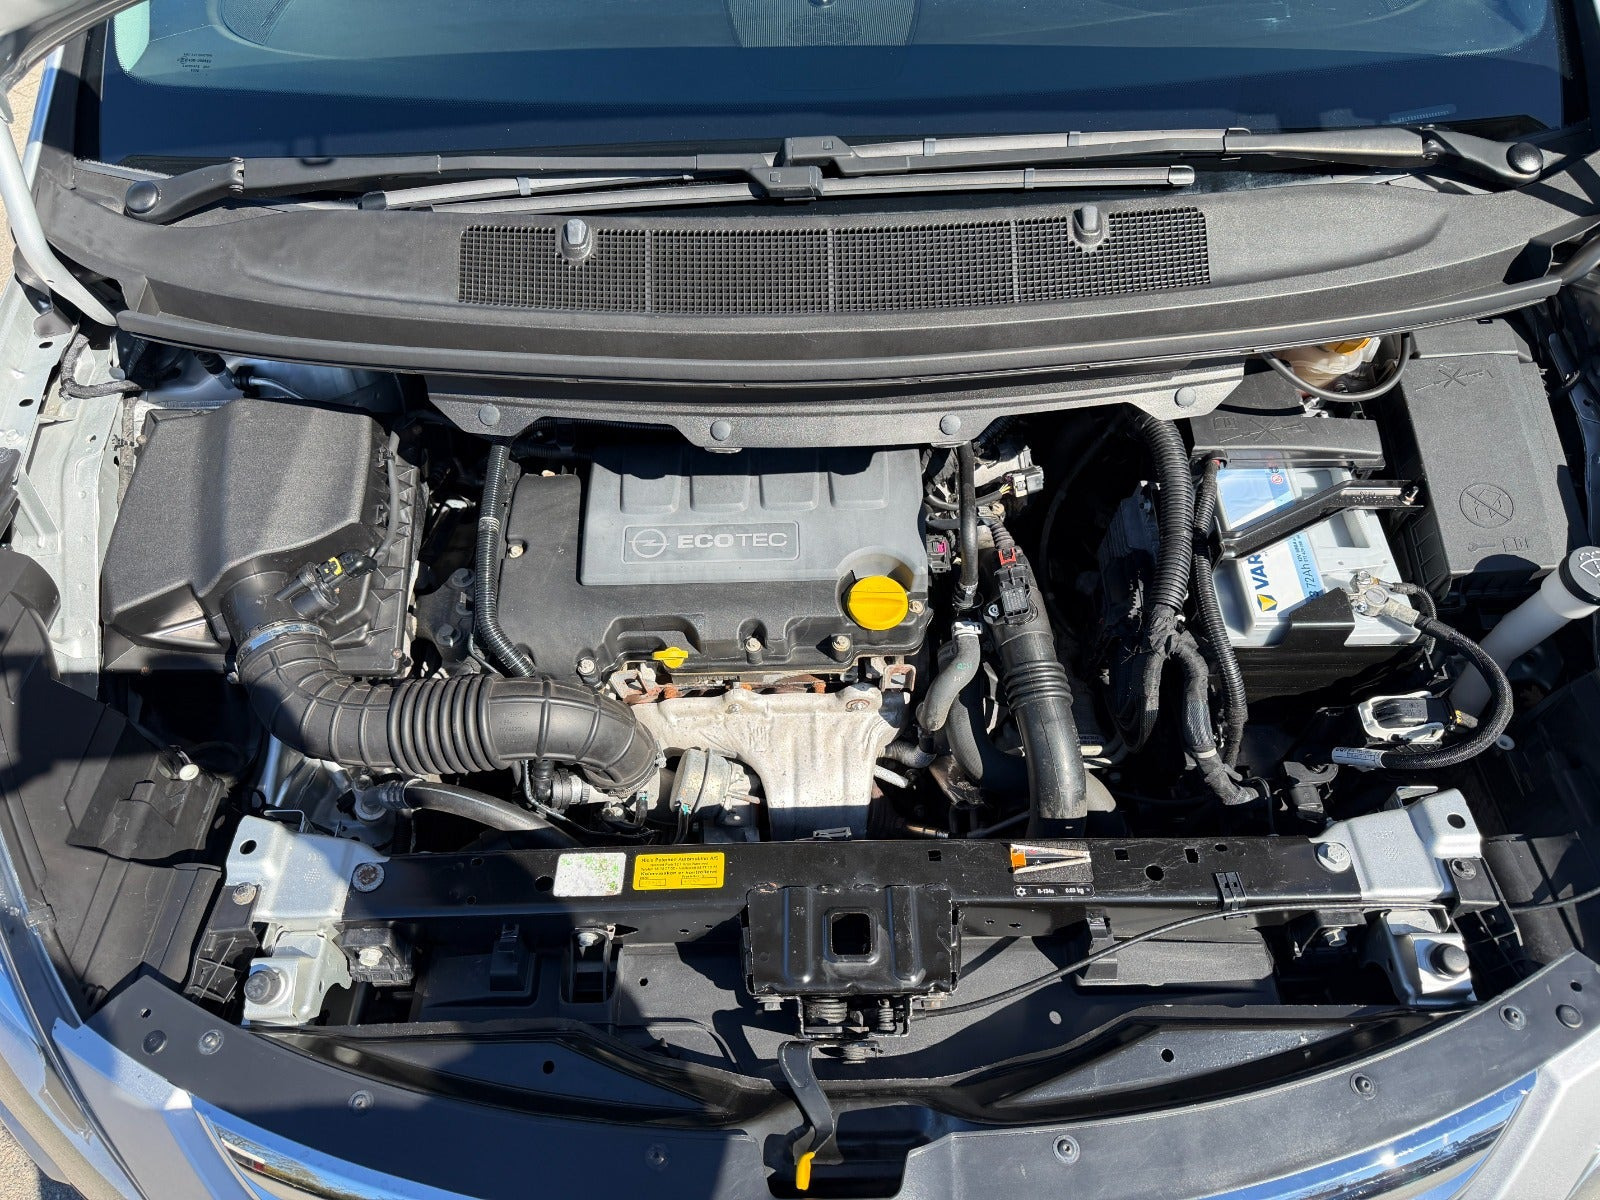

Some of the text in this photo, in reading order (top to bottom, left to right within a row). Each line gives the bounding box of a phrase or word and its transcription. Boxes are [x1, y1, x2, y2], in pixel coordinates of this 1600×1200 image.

[677, 532, 788, 549] ECOTEC
[1247, 554, 1269, 590] VAR
[1301, 563, 1316, 588] 72Ah
